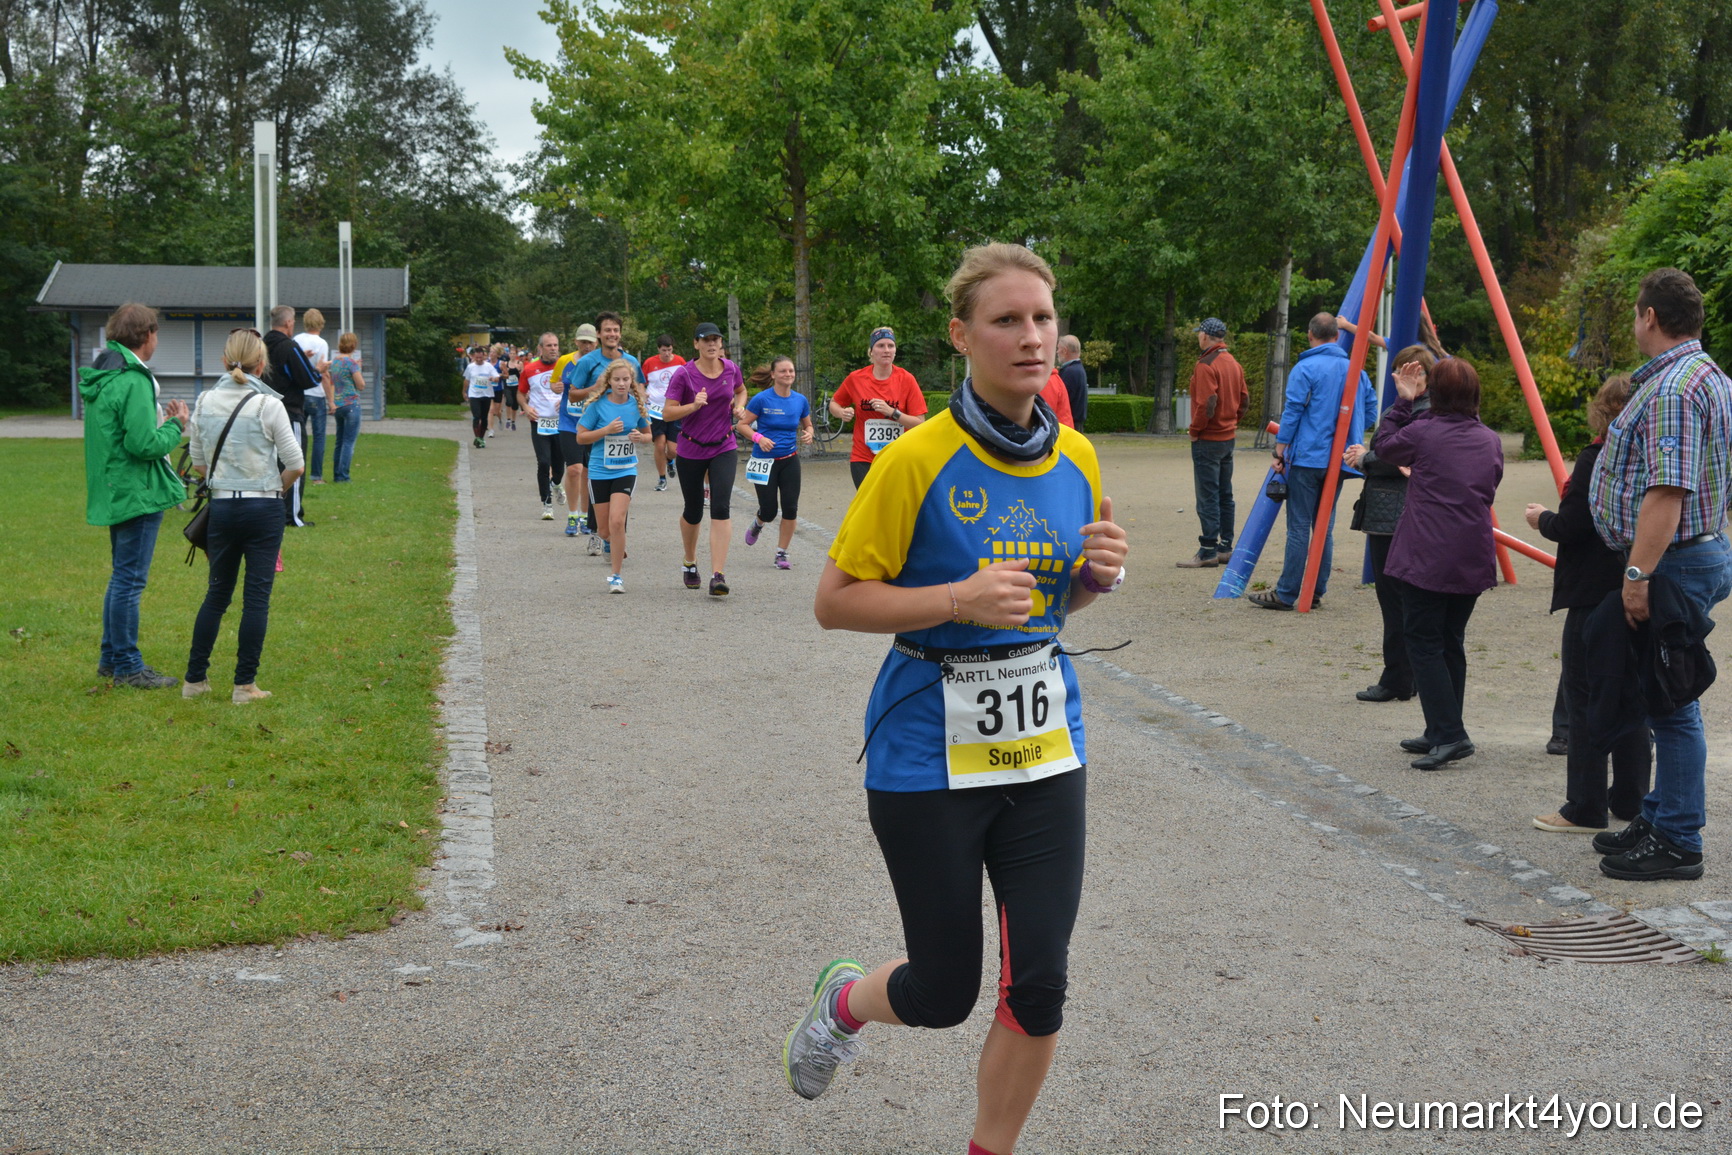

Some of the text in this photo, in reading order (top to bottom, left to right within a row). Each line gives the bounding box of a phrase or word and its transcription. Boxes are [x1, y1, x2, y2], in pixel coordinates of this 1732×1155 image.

[869, 427, 901, 440] 2393
[608, 442, 635, 456] 2760
[963, 490, 973, 498] 15
[1036, 575, 1057, 585] 2014
[894, 643, 925, 659] GARMIN
[1008, 642, 1041, 658] GARMIN
[943, 653, 991, 663] GARMIN
[946, 662, 1047, 684] PARTL Neumarkt
[977, 680, 1049, 736] 316
[989, 744, 1042, 768] Sophie
